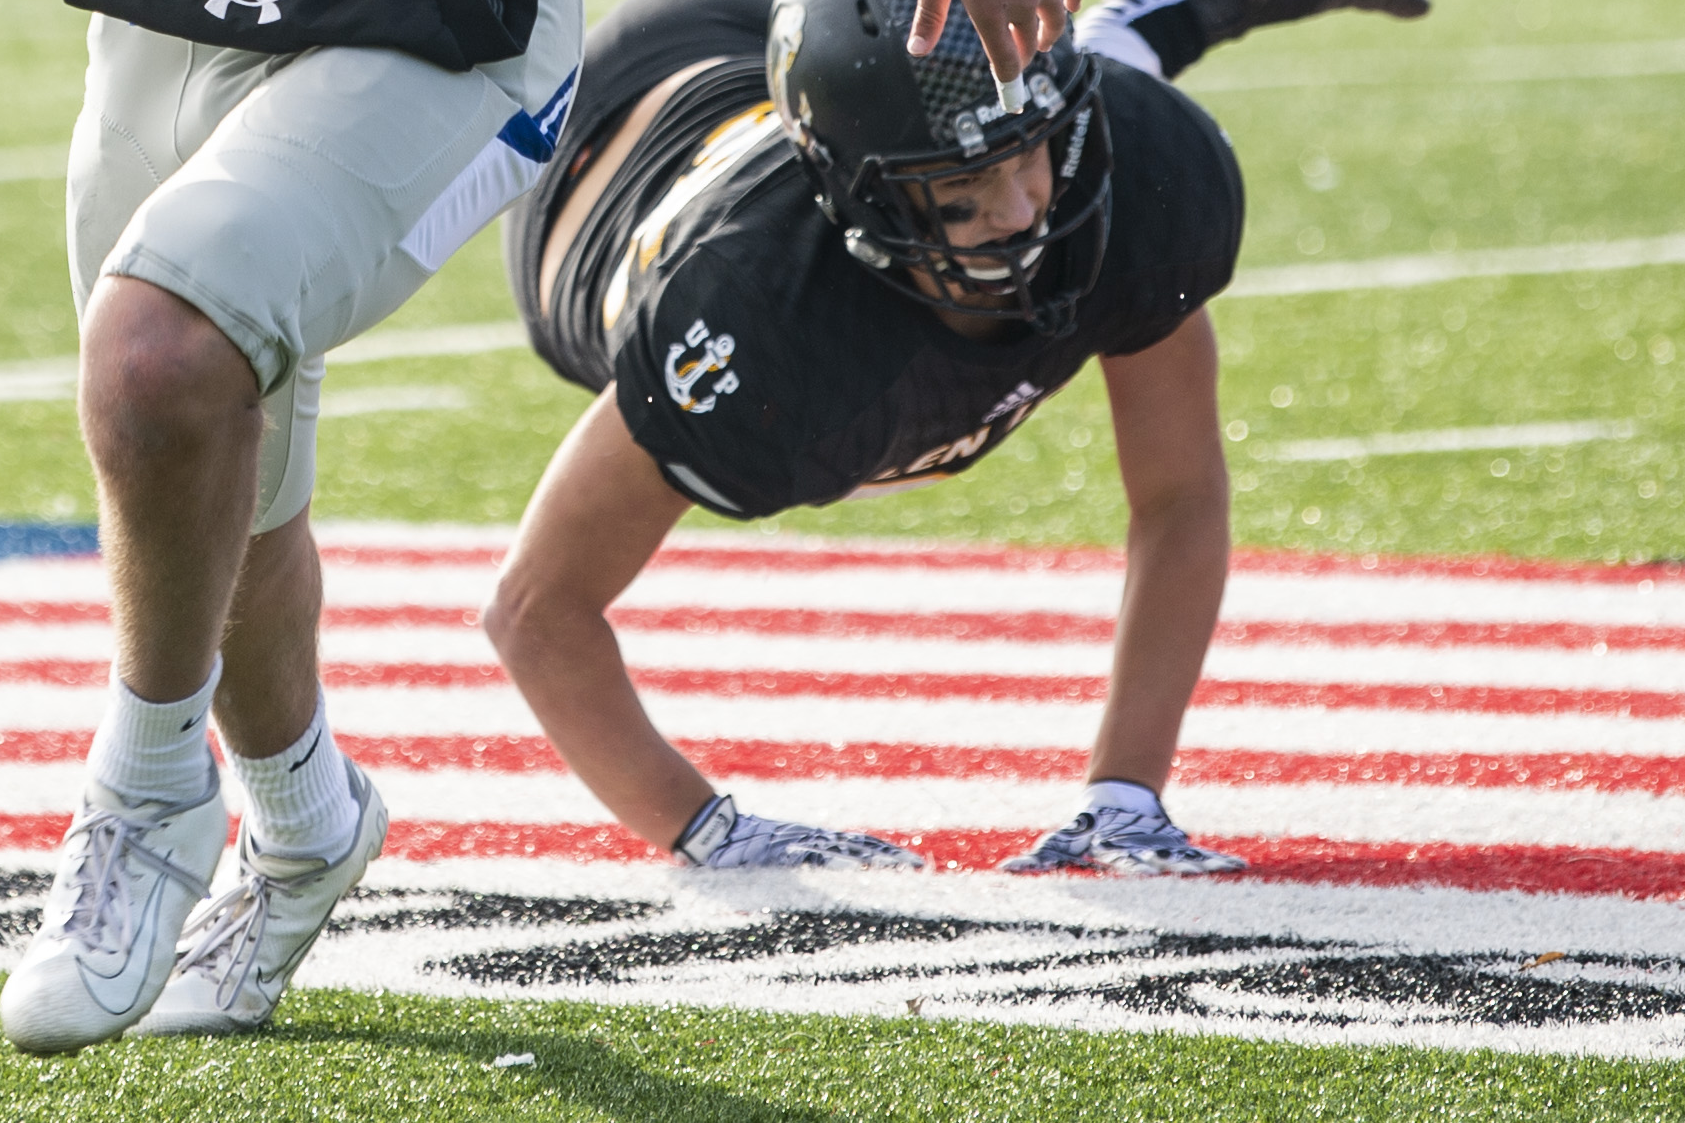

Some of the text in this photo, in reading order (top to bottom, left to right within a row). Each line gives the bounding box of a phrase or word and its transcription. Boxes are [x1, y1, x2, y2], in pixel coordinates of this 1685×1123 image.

[1060, 108, 1093, 178] Riddell
[684, 318, 710, 348] U
[712, 369, 740, 394] P
